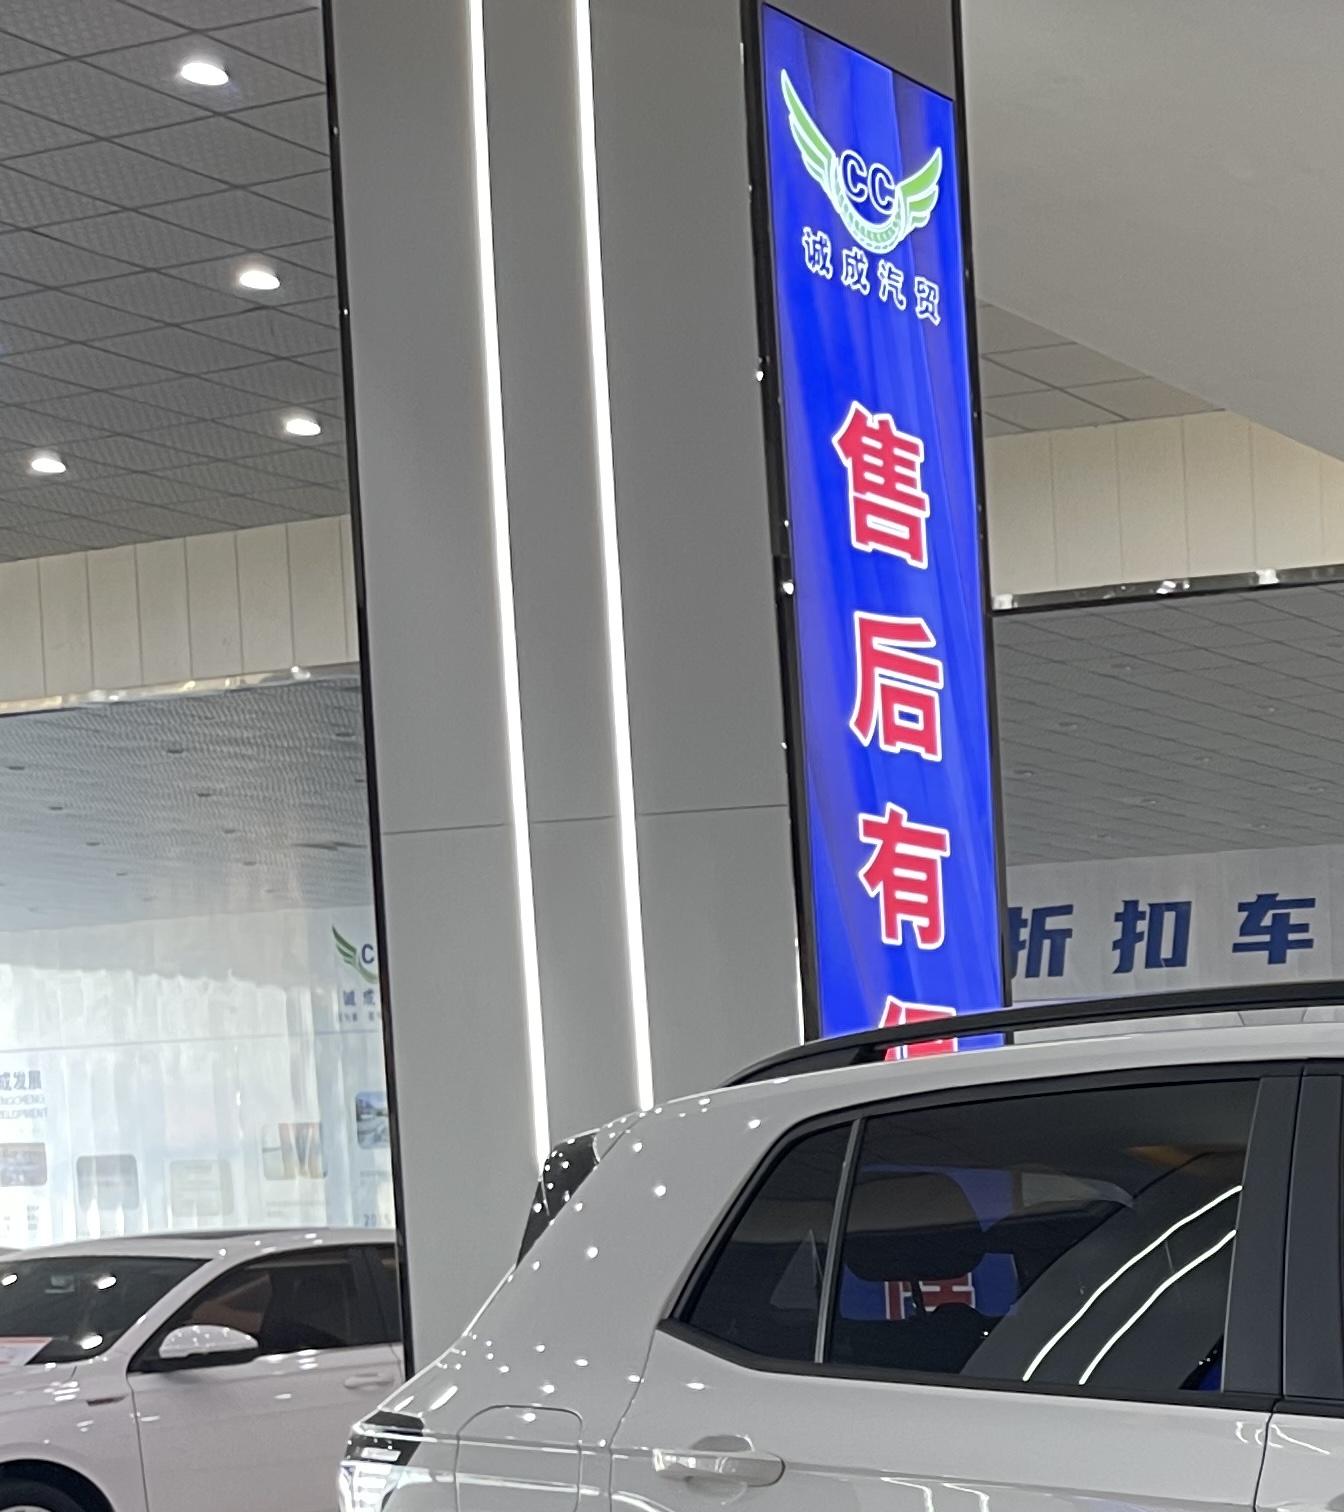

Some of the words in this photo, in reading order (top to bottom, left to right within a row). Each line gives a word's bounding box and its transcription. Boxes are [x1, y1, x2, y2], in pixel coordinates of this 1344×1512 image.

[839, 149, 898, 215] CC
[802, 226, 941, 326] 诚成汽贸
